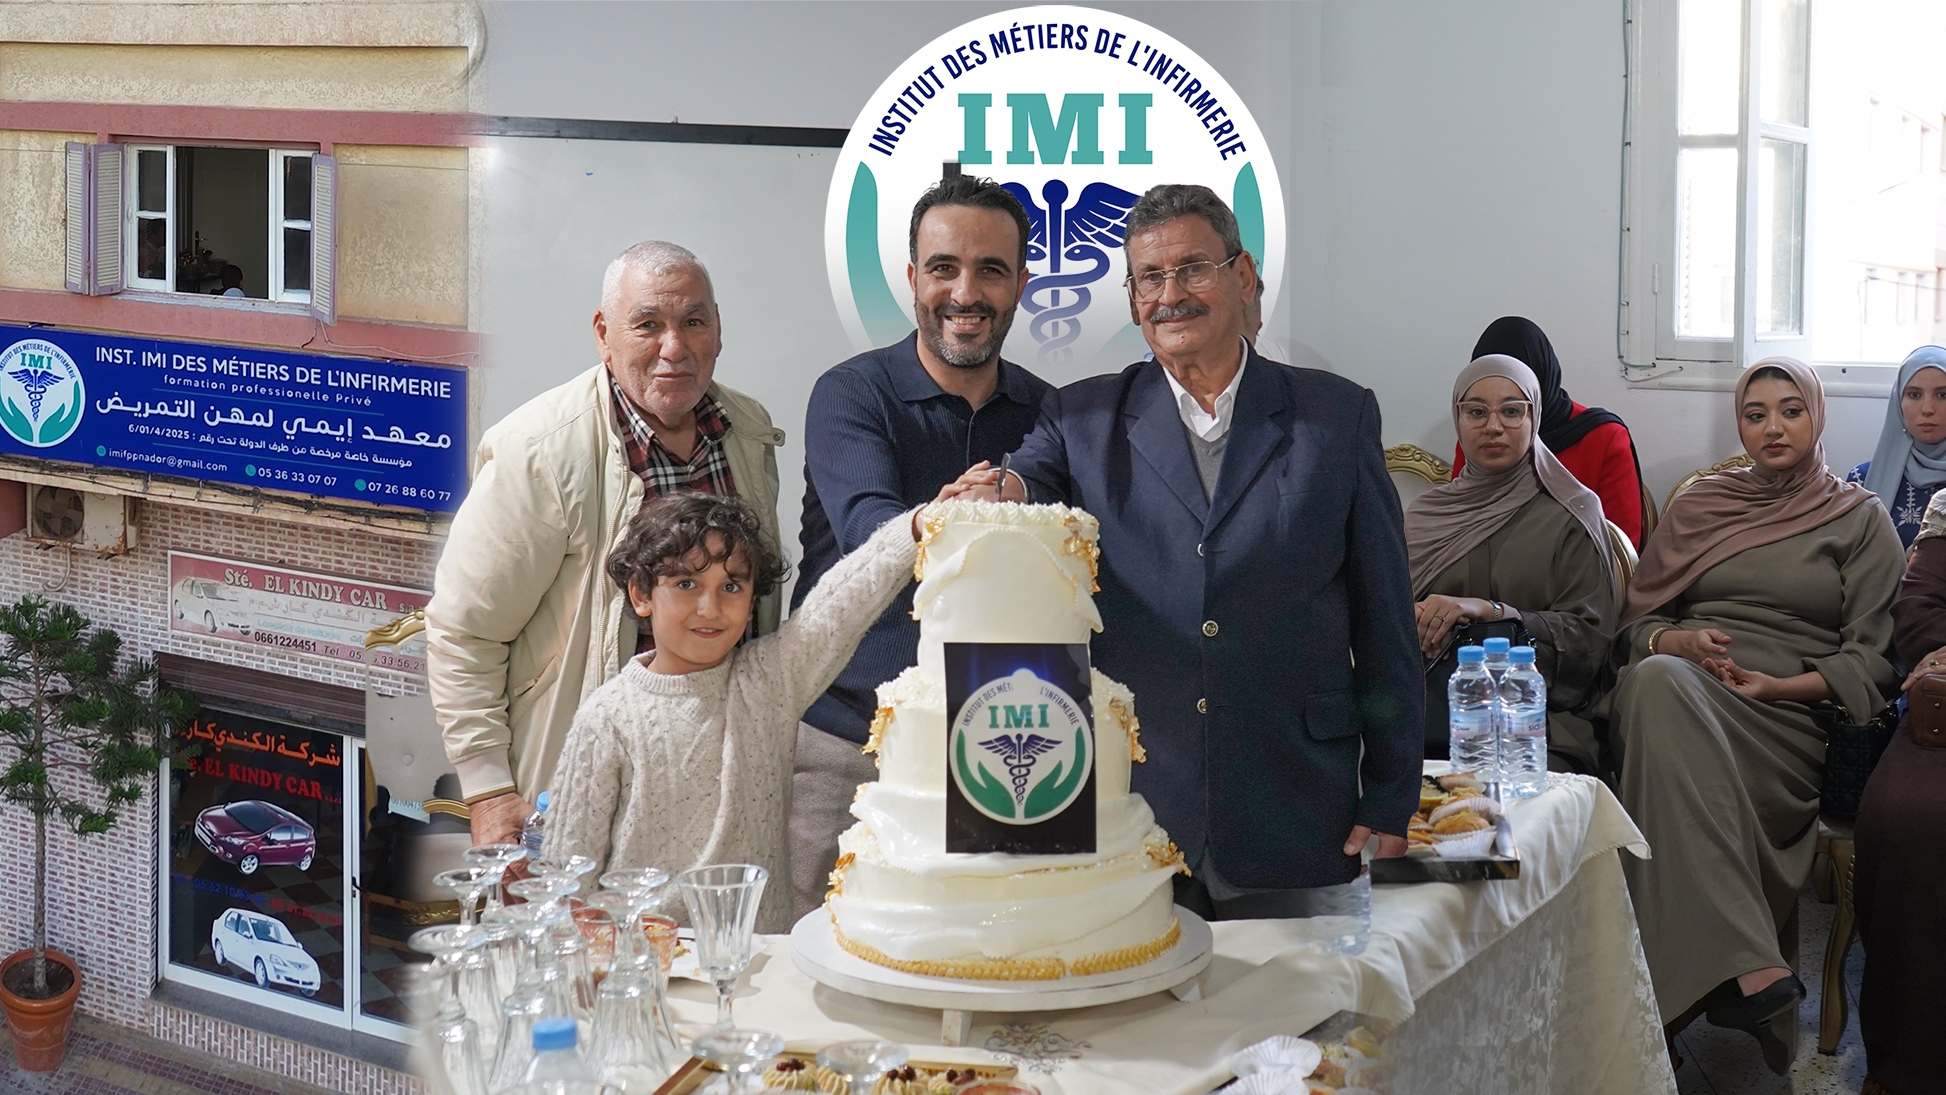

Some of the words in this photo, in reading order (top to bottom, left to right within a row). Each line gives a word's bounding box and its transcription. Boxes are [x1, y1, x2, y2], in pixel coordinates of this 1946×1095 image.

[20, 352, 53, 370] IMI
[95, 346, 137, 366] INST.
[141, 351, 167, 369] IMI
[172, 354, 207, 373] DES
[212, 356, 290, 382] MÉTIERS
[296, 366, 322, 385] DE
[163, 374, 226, 391] formation
[231, 383, 330, 403] professionelle
[335, 393, 372, 407] Privé
[95, 391, 196, 419] التمريض
[203, 405, 274, 428] لمهن
[128, 423, 190, 440] 6/01/4/2025
[199, 433, 214, 445] رقم
[216, 435, 237, 446] تحت
[282, 417, 353, 444] إيمي
[361, 425, 452, 449] معهد
[238, 437, 266, 450] الدولة
[268, 442, 289, 454] طرف
[291, 445, 307, 455] من
[309, 446, 342, 461] مرخصة
[108, 448, 228, 472] imifppnador@gmail.com
[344, 451, 369, 463] خاصة
[372, 454, 413, 469] مؤسسة
[258, 467, 272, 479] 05
[274, 469, 289, 480] 36
[291, 472, 305, 483] 33
[307, 474, 321, 484] 07
[323, 476, 337, 486] 07
[368, 481, 382, 492] 07
[384, 484, 399, 495] 26
[401, 486, 417, 498] 88
[419, 489, 436, 500] 60
[438, 491, 452, 502] 77
[223, 567, 253, 589] Sté.
[263, 573, 285, 594] EL
[288, 578, 344, 604] KINDY
[349, 588, 388, 611] CAR
[254, 631, 317, 652] 0661224451
[349, 649, 426, 671] 05..33.56.21
[962, 697, 986, 728] INSTITUT
[983, 688, 997, 702] DES
[1039, 685, 1080, 726] L'INFIRMERIE
[988, 703, 1050, 729] IMI
[214, 730, 275, 753] الكندي
[276, 733, 341, 768] شركة
[204, 757, 224, 778] EL
[228, 763, 283, 790] KINDY
[285, 776, 323, 800] CAR
